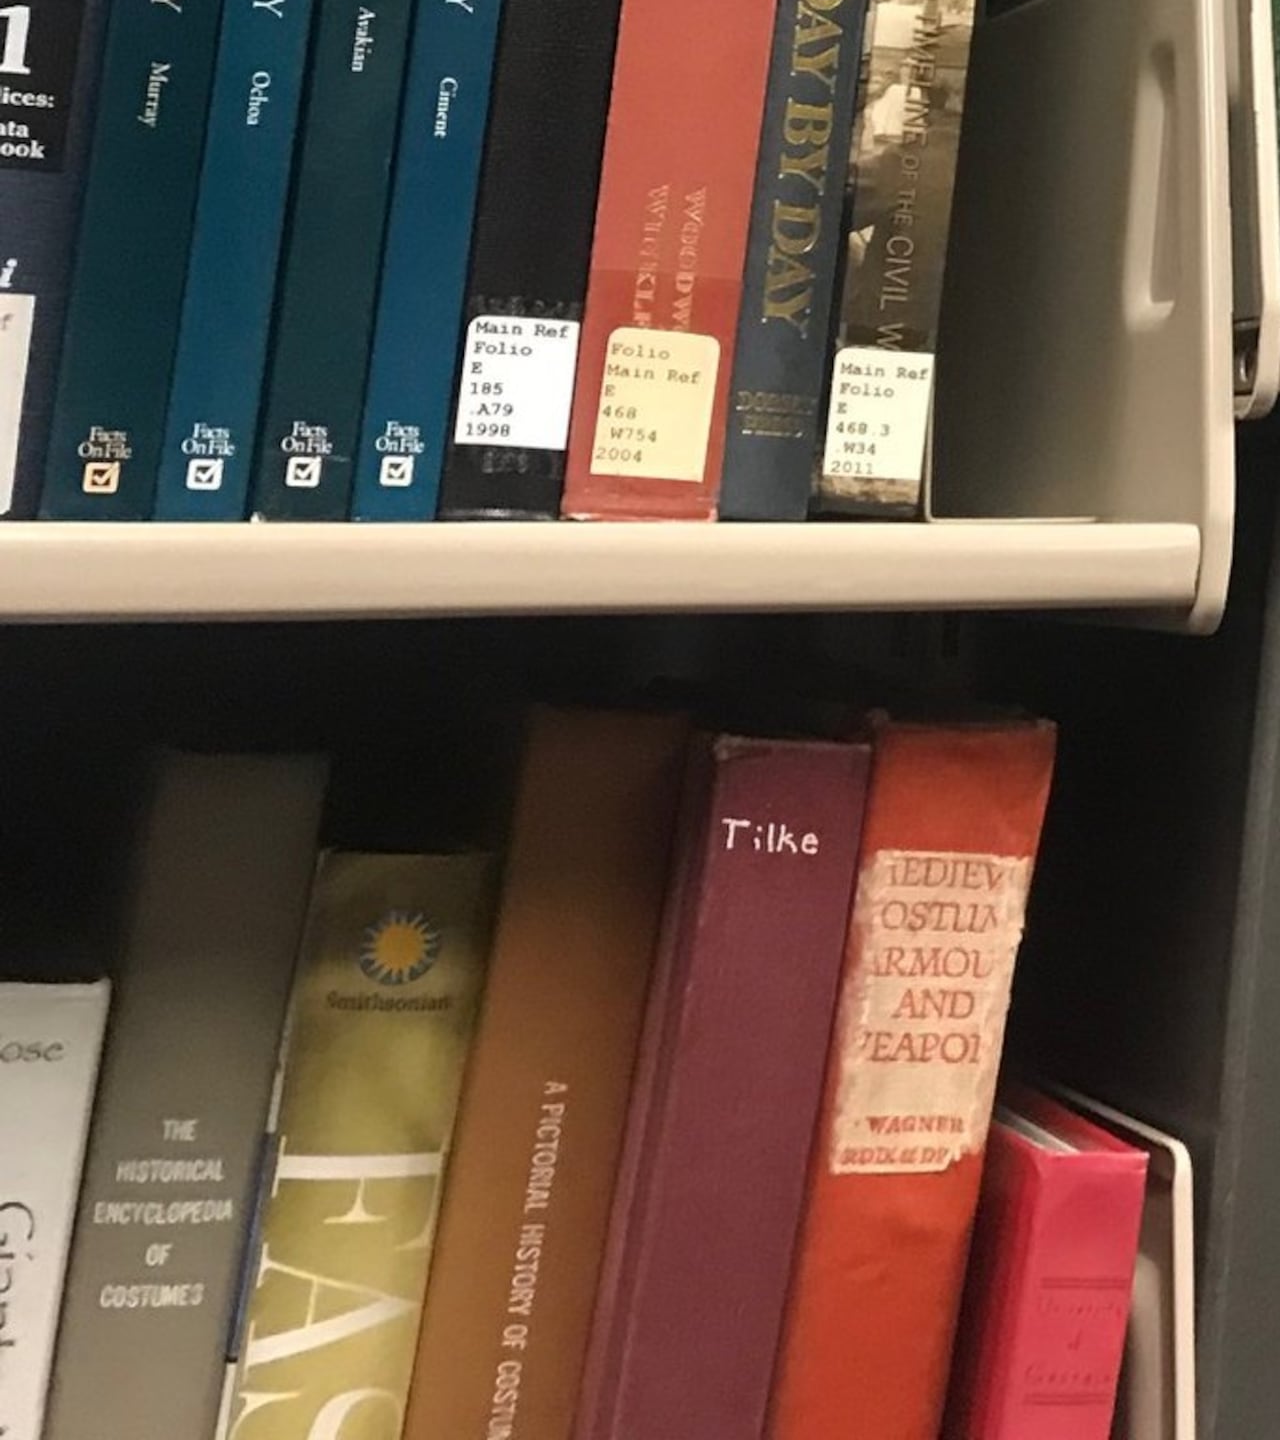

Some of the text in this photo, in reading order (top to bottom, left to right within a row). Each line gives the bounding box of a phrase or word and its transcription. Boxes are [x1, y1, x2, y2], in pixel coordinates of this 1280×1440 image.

[351, 6, 378, 73] Avakian
[902, 12, 941, 146] TIMELINE
[136, 61, 172, 129] Murray
[246, 70, 272, 126] Ochoa
[433, 77, 459, 138] Ciment
[779, 97, 835, 194] BY
[761, 206, 823, 339] DAY
[880, 236, 914, 311] CIVIL
[476, 321, 569, 339] Main Ref
[474, 341, 534, 358] Folio
[471, 361, 482, 375] E
[841, 362, 929, 381] Main Ref
[470, 380, 504, 397] 185
[839, 383, 895, 399] Folio
[837, 401, 848, 415] E
[465, 422, 512, 439] 1998
[836, 420, 891, 437] 468.3
[830, 460, 875, 476] 2011
[721, 818, 820, 855] Tilke
[326, 990, 451, 1014] Smithsonian
[891, 988, 974, 1020] AND
[163, 1120, 196, 1142] THE
[866, 1116, 964, 1134] WAGNER
[116, 1159, 226, 1183] HISTORICAL
[94, 1201, 234, 1225] ENCYCLOPEDIA
[502, 1081, 568, 1351] A PICTORIAL HISTORY OF
[145, 1244, 172, 1268] OF
[100, 1282, 204, 1309] COSTUMES
